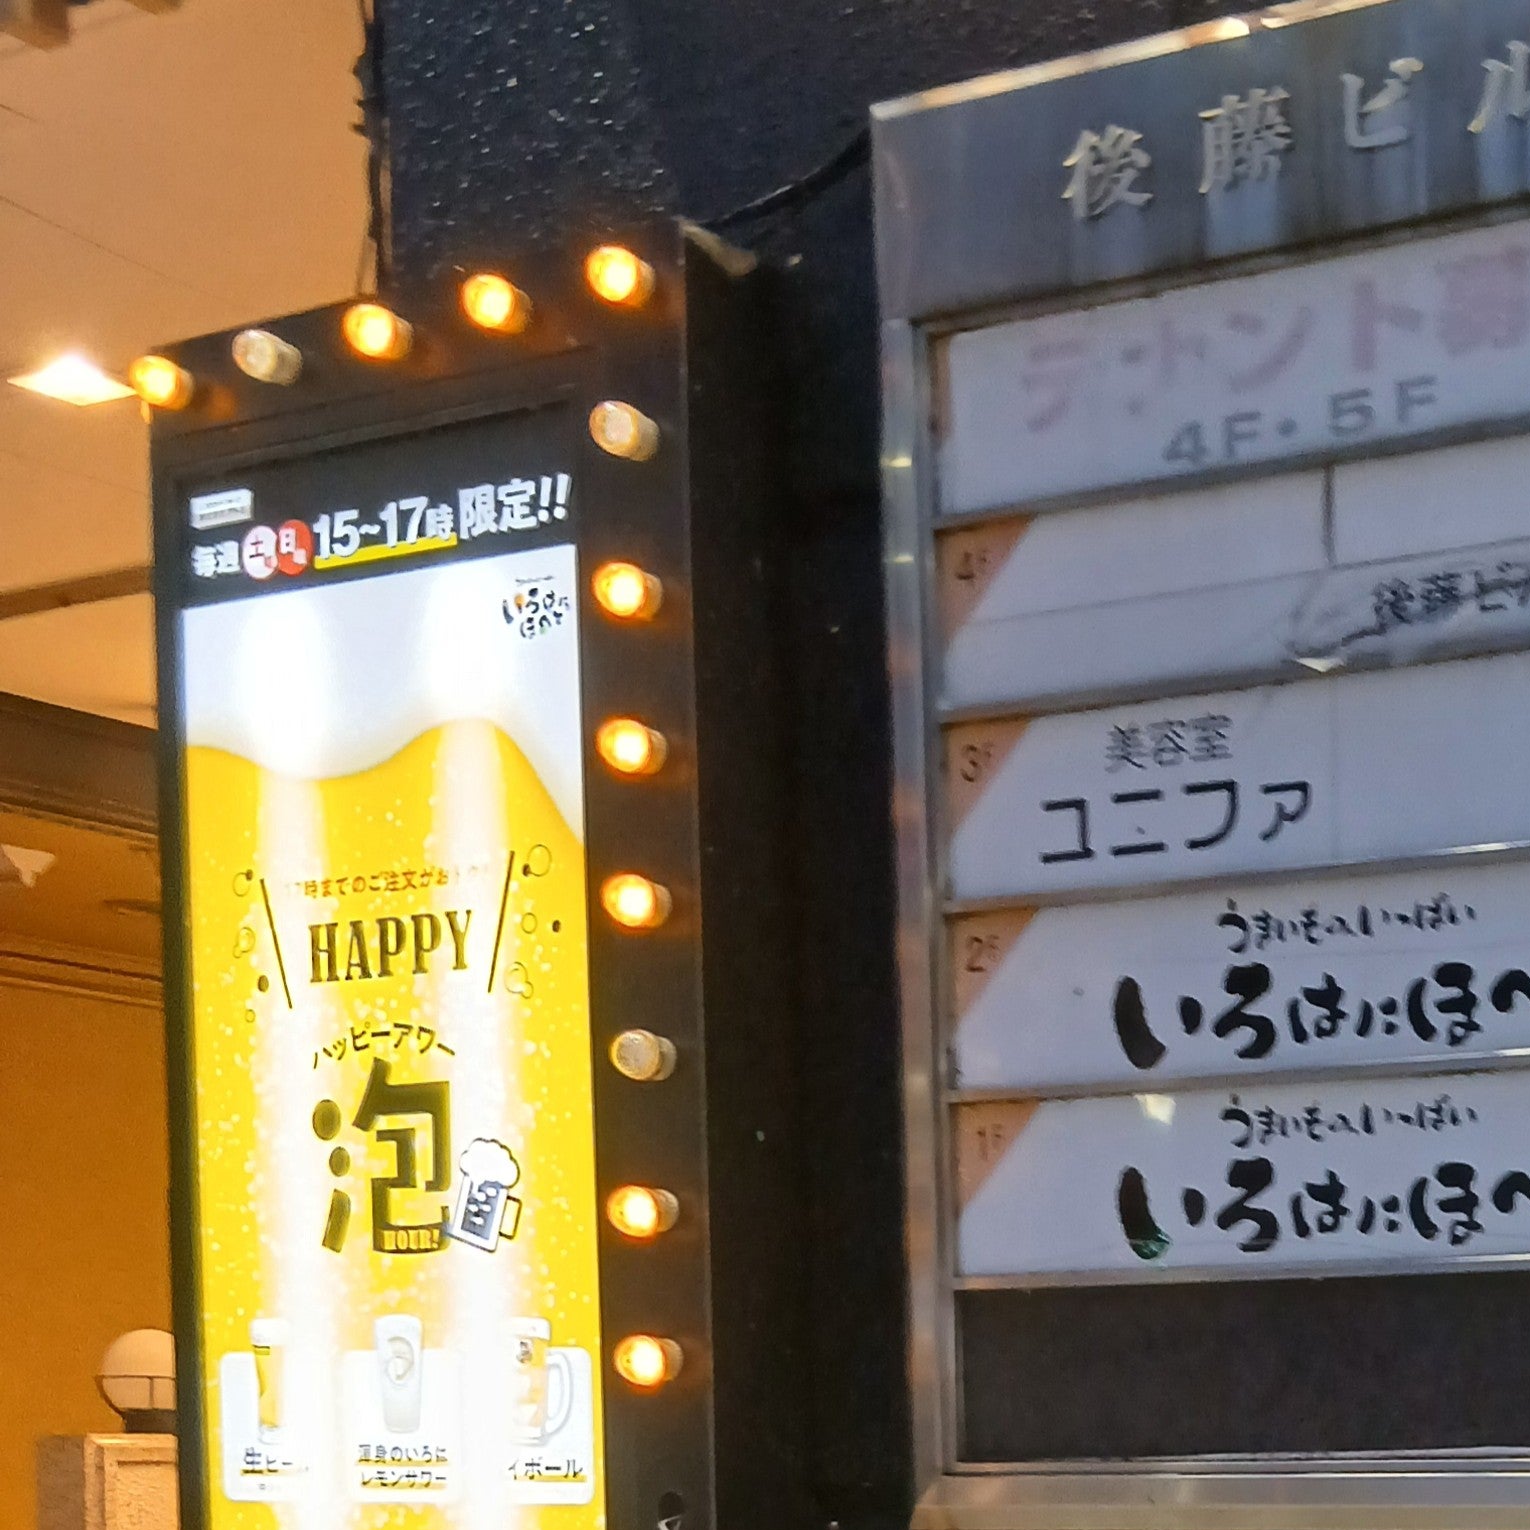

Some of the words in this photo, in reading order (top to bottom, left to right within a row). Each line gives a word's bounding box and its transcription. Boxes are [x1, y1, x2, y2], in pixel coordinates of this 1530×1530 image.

[1104, 713, 1233, 774] 美容室
[309, 909, 472, 983] HAPPY
[312, 1021, 456, 1069] ハッピーアワー
[312, 1057, 450, 1254] 泡
[242, 1446, 310, 1474] 生ビー
[360, 1470, 448, 1488] レモンサワー
